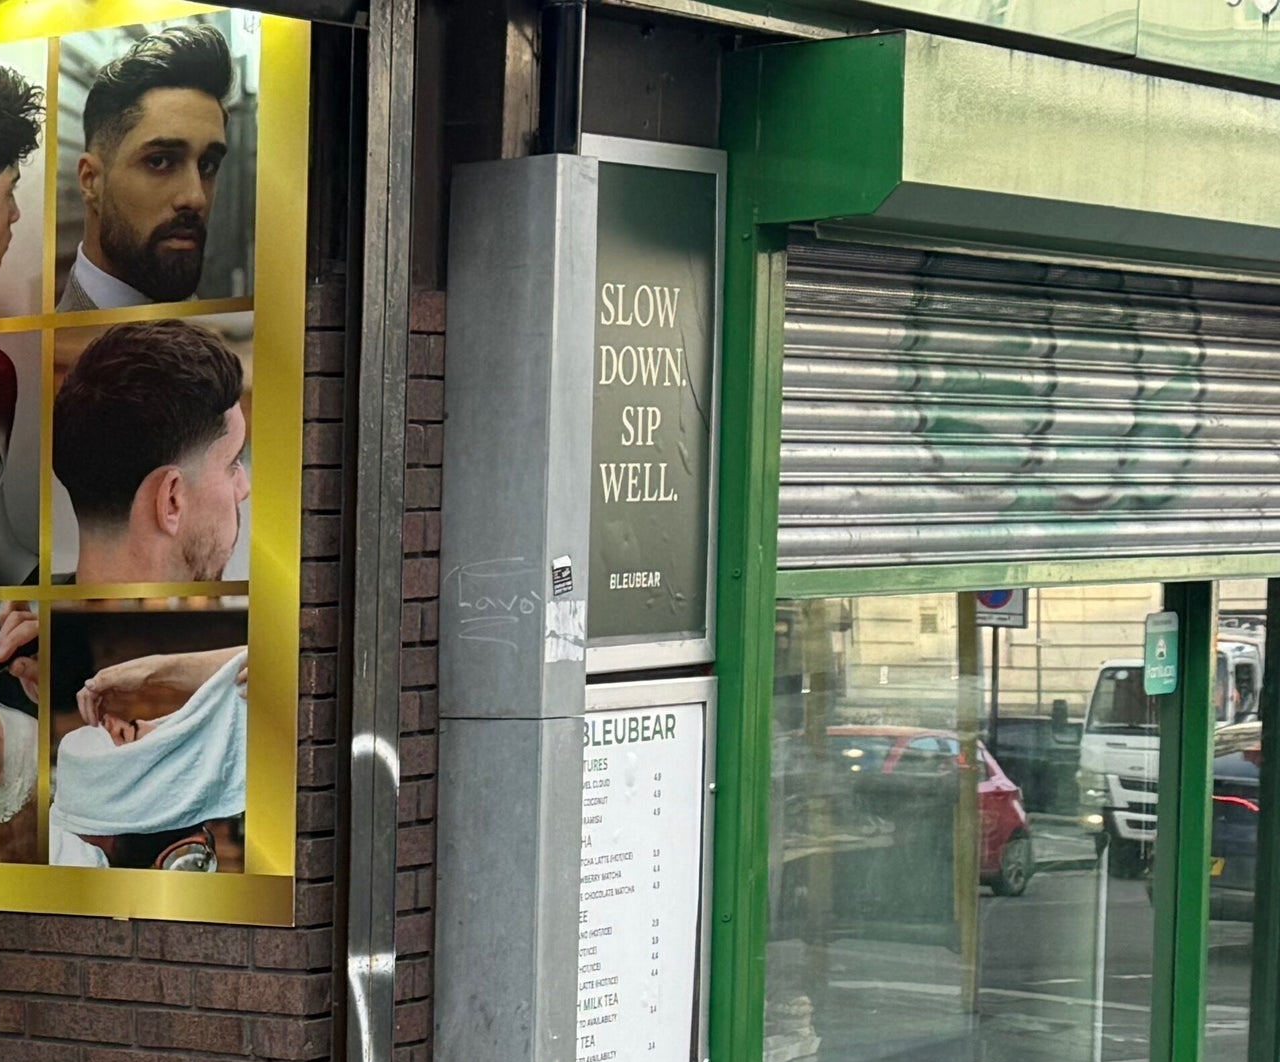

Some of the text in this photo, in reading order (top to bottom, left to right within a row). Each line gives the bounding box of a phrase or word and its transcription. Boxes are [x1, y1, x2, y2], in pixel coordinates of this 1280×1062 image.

[600, 283, 680, 328] SLOW
[599, 345, 687, 386] DOWN.
[621, 406, 661, 446] SIP
[600, 463, 678, 503] WELL.
[609, 572, 661, 590] BLEUBEAR
[583, 714, 676, 747] BLEUBEAR
[583, 796, 608, 807] COCONUT
[584, 888, 614, 901] CHOCOLATE
[583, 996, 603, 1011] MILK
[604, 993, 619, 1007] TEA
[580, 1035, 595, 1049] TEA
